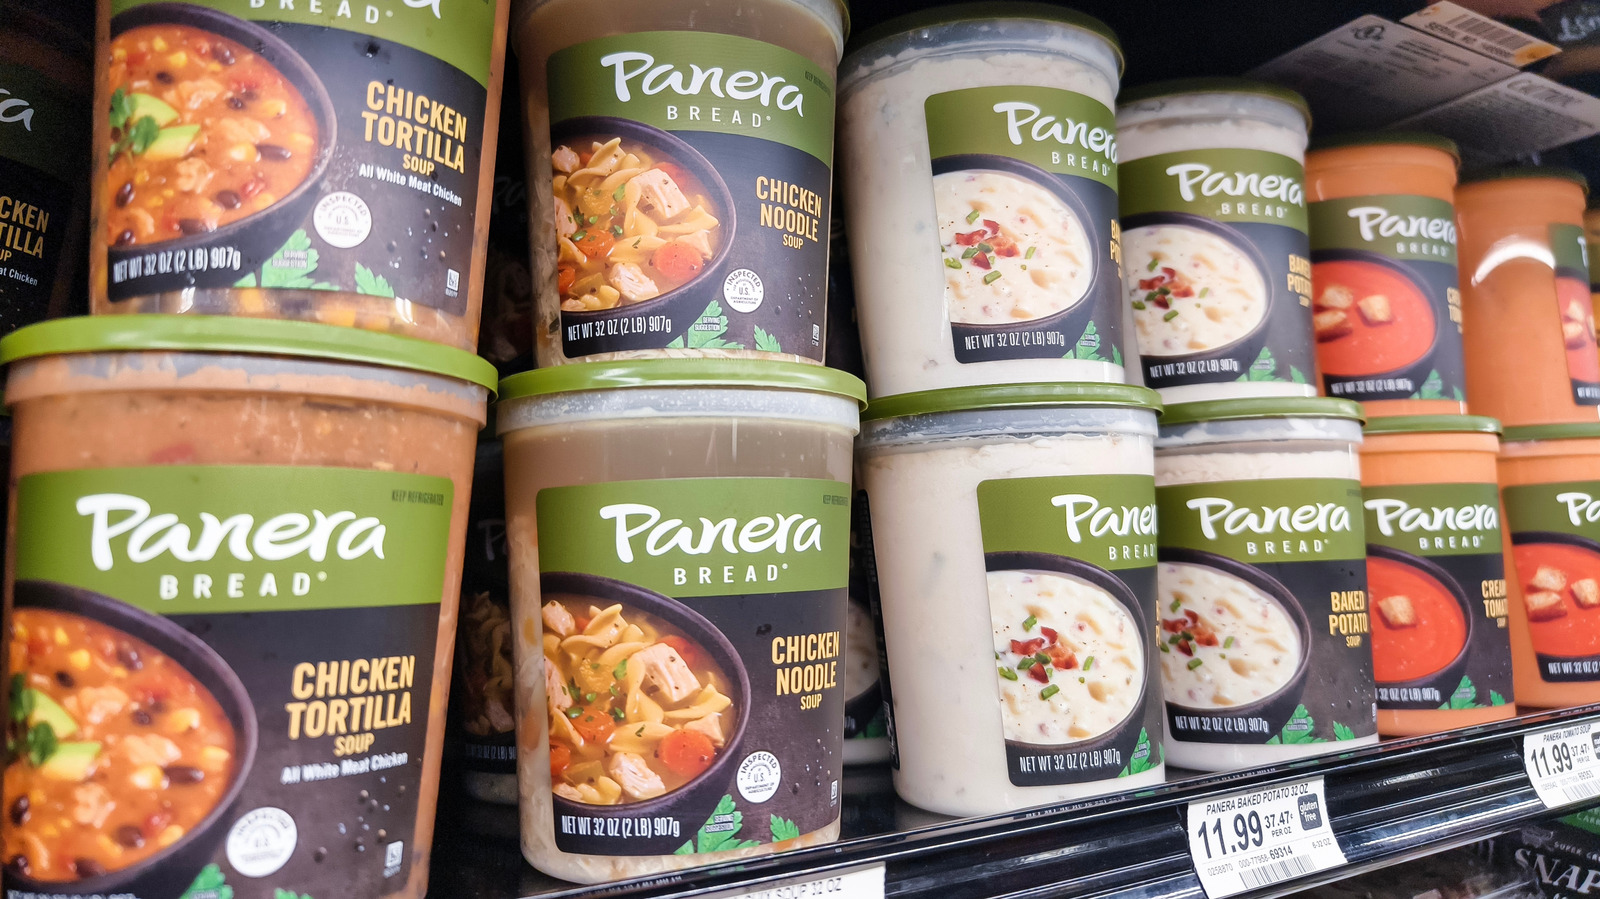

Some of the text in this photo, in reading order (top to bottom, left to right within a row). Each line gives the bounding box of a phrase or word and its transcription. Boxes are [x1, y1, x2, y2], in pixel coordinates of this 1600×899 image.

[600, 52, 804, 118] Panera
[366, 81, 467, 143] CHICKEN
[361, 110, 465, 174] TORTILLA
[402, 153, 435, 176] SOUP
[359, 163, 462, 207] All White Meat Chicken
[756, 175, 822, 218] CHICKEN
[1166, 163, 1303, 208] Panera
[0, 196, 49, 234] CKEN
[760, 203, 818, 242] NOODLE
[0, 221, 44, 259] TILLA
[782, 233, 804, 250] SOUP
[143, 253, 157, 276] 32
[157, 251, 173, 274] OZ
[174, 249, 186, 274] (2
[188, 248, 208, 271] LB)
[210, 246, 241, 271] 907g
[9, 269, 38, 286] Chicken
[727, 270, 761, 287] INSPECTED
[568, 315, 672, 342] NET WT 32 OZ (2 LB) 907g
[965, 335, 980, 350] NET
[981, 334, 995, 349] WT
[997, 333, 1007, 347] 32
[1009, 332, 1021, 346] OZ
[1022, 332, 1031, 347] (2
[1032, 331, 1045, 346] LB)
[1046, 331, 1065, 346] 907g
[1176, 363, 1186, 375] 32
[1186, 361, 1197, 373] OZ
[1198, 360, 1207, 373] (2
[1207, 360, 1219, 373] LB)
[1220, 358, 1239, 372] 907g
[76, 493, 387, 571] Panera
[1186, 497, 1351, 540] Panera
[1364, 498, 1498, 537] Panera
[600, 503, 822, 563] Panera
[1330, 590, 1365, 612] BAKED
[1328, 612, 1368, 636] POTATO
[771, 631, 840, 665] CHICKEN
[1345, 635, 1362, 648] SOUP
[291, 654, 416, 700] CHICKEN
[776, 661, 837, 696] NOODLE
[284, 691, 412, 741] TORTILLA
[800, 693, 823, 711] SOUP
[1175, 716, 1269, 733] NET WT 32 OZ (2 LB) 907g
[333, 732, 375, 757] SOUP
[280, 751, 409, 785] All White Meat Chicken
[741, 753, 777, 774] INSPECTED
[1019, 756, 1035, 772] NET
[1038, 755, 1051, 771] WT
[1054, 754, 1064, 770] 32
[1067, 753, 1078, 769] OZ
[1079, 752, 1088, 770] (2
[1089, 750, 1102, 768] LB)
[1103, 748, 1121, 765] 907g
[1531, 742, 1573, 778] 11.99
[1206, 783, 1309, 815] PANERA BAKED POTATO 32 OZ
[1299, 801, 1318, 815] gluten
[561, 815, 681, 839] NET WT 32 OZ (2 LB) 907g
[1271, 826, 1292, 838] PER OZ
[1304, 812, 1317, 822] free
[1198, 810, 1264, 859] 11.99
[1325, 837, 1332, 847] OZ
[827, 878, 842, 893] OZ
